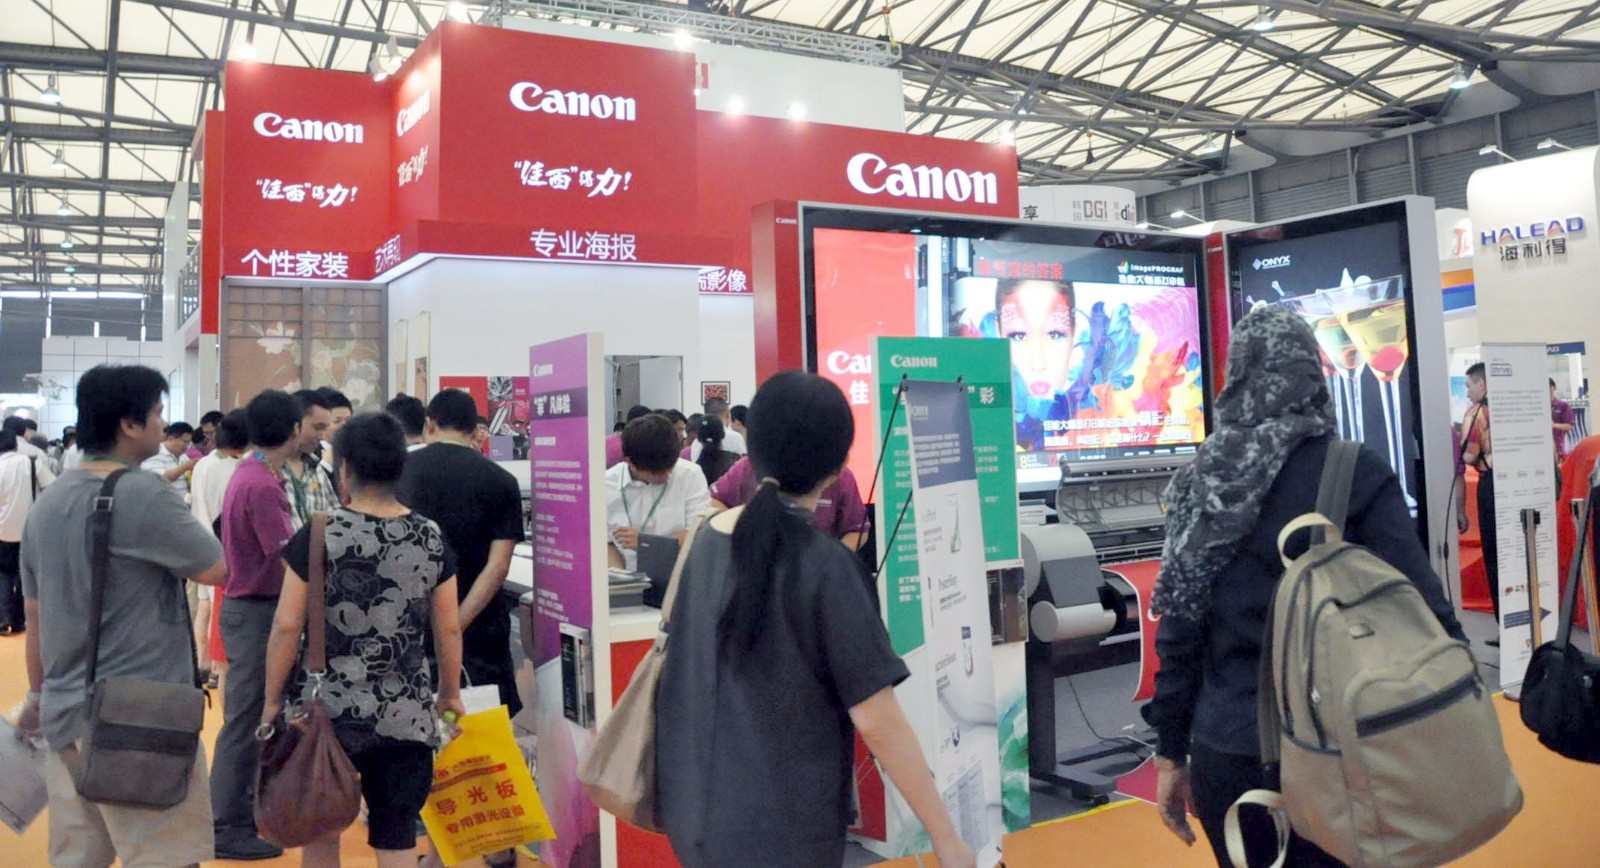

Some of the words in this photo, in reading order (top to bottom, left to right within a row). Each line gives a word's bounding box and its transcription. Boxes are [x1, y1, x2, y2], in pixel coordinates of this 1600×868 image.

[396, 89, 431, 137] Canon
[509, 81, 636, 121] Canon
[253, 112, 364, 144] Canon
[846, 152, 997, 204] Canon
[1083, 200, 1107, 218] DGI
[530, 228, 637, 260] 专业海报
[1481, 216, 1584, 246] HALEAD
[241, 248, 348, 278] 个性家装
[1261, 255, 1291, 267] ONYX
[1500, 237, 1566, 261] 海利得
[533, 363, 554, 377] Canon
[890, 354, 938, 368] Canon
